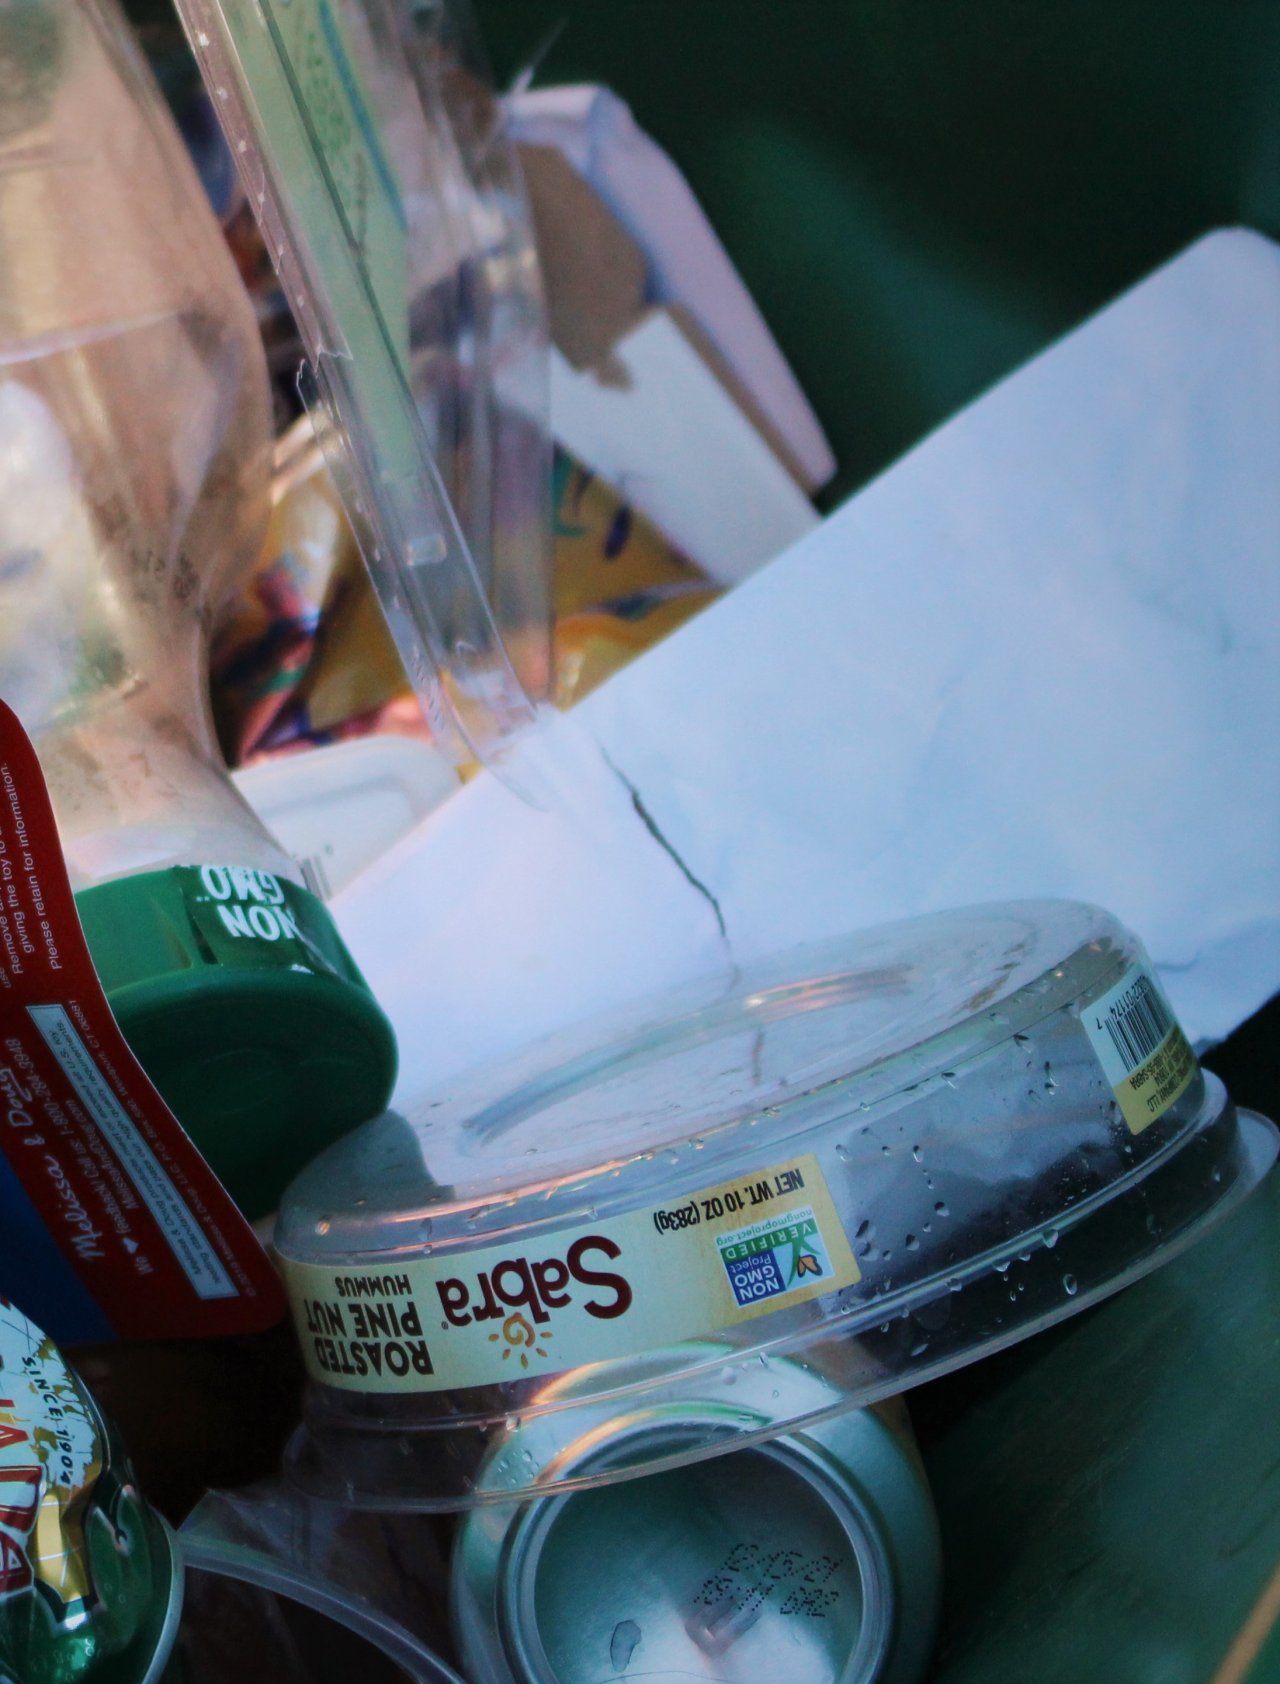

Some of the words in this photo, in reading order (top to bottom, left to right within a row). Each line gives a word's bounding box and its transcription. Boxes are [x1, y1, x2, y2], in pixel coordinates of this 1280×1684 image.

[21, 850, 35, 871] for
[5, 884, 19, 908] the
[27, 874, 46, 917] retain
[200, 863, 283, 901] GMO
[12, 910, 35, 954] giving
[217, 904, 295, 941] NON
[39, 920, 61, 970] Please
[742, 1175, 774, 1206] WT.
[774, 1167, 804, 1196] NET
[41, 1152, 105, 1260] Melissa
[651, 1198, 701, 1237] (283g)
[700, 1193, 725, 1221] OZ
[723, 1189, 744, 1213] 10
[714, 1203, 812, 1245] nongmoproject.org
[723, 1221, 812, 1258] VERIFIED
[728, 1251, 771, 1274] Project
[732, 1262, 774, 1286] GMO
[333, 1271, 412, 1298] HUMMUS
[435, 1231, 635, 1331] Sabra
[736, 1275, 779, 1300] NON
[302, 1298, 346, 1332] NUT
[348, 1299, 422, 1335] PINE
[311, 1337, 434, 1373] ROASTED
[20, 1353, 62, 1420] SINCE
[55, 1428, 73, 1486] 1904
